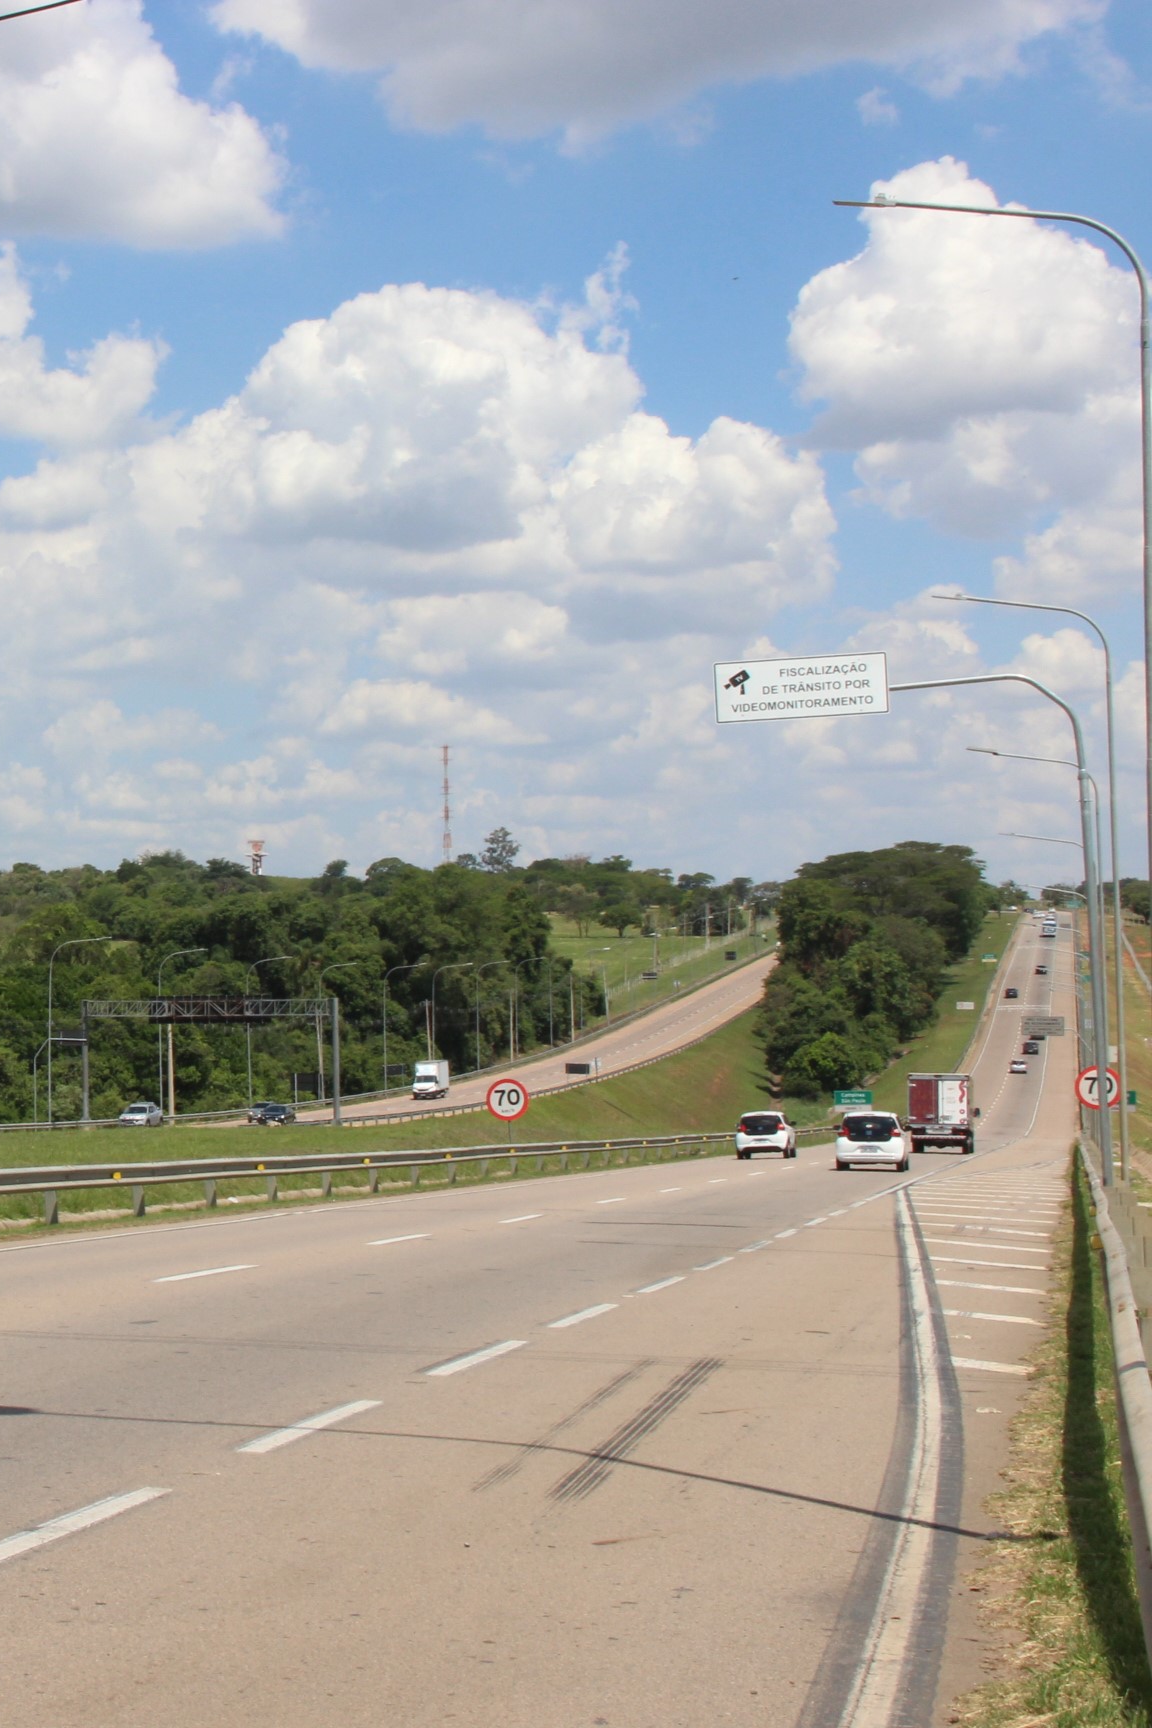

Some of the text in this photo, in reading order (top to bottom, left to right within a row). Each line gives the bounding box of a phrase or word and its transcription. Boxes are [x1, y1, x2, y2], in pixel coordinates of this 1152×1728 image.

[779, 662, 867, 677] FISCALIZAÇÃO
[762, 679, 870, 695] DE TRÂNSITO POR
[731, 695, 874, 713] VIDEOMONITORAMENTO
[1084, 1077, 1113, 1094] 70
[494, 1089, 520, 1106] 70
